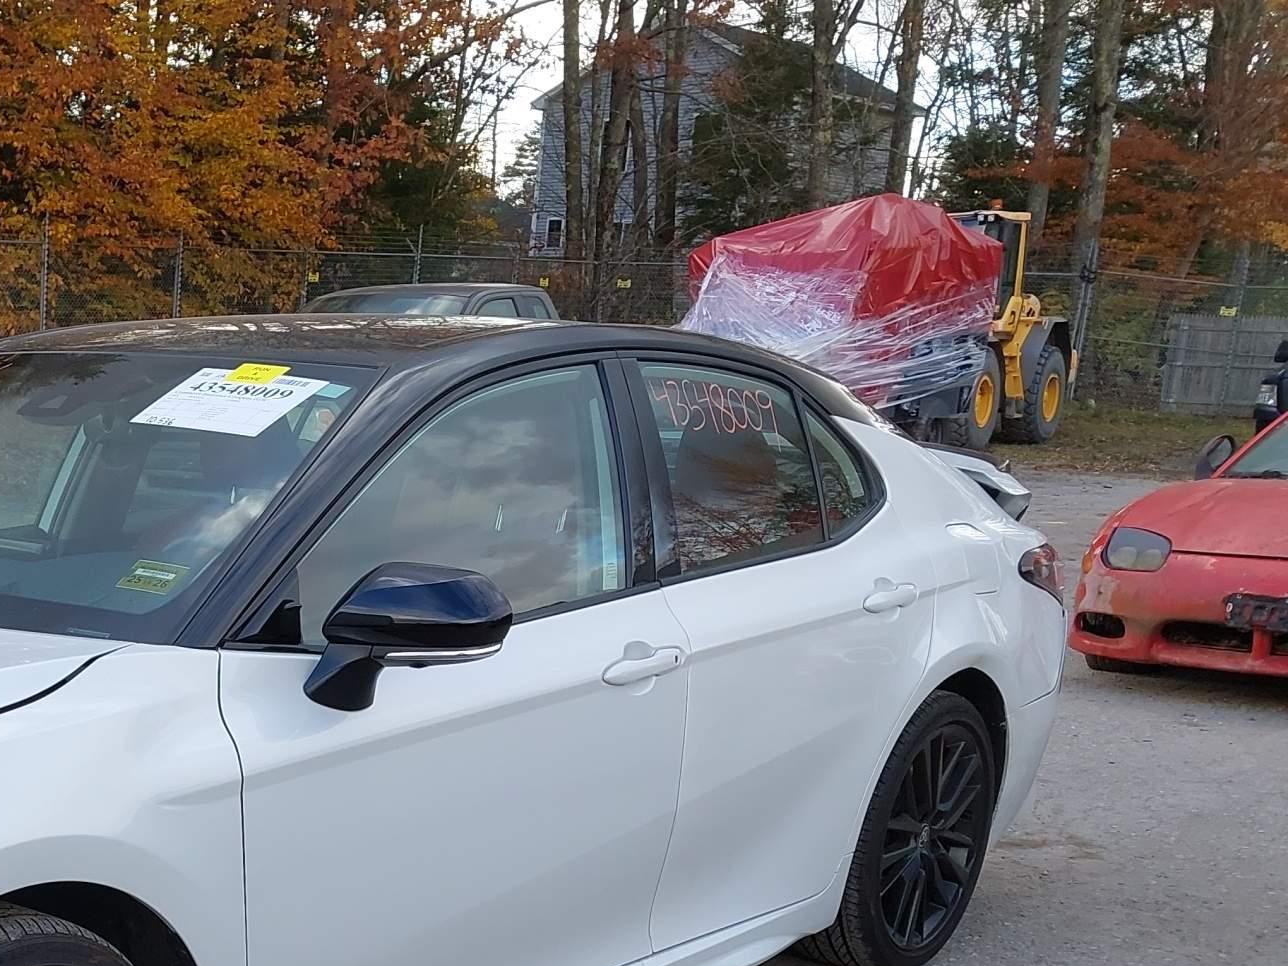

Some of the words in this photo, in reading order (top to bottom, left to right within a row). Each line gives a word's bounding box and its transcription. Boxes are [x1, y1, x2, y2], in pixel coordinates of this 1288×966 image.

[189, 381, 294, 400] 43548009
[647, 379, 781, 448] 43548009
[127, 575, 144, 584] 25
[152, 580, 169, 589] 26
